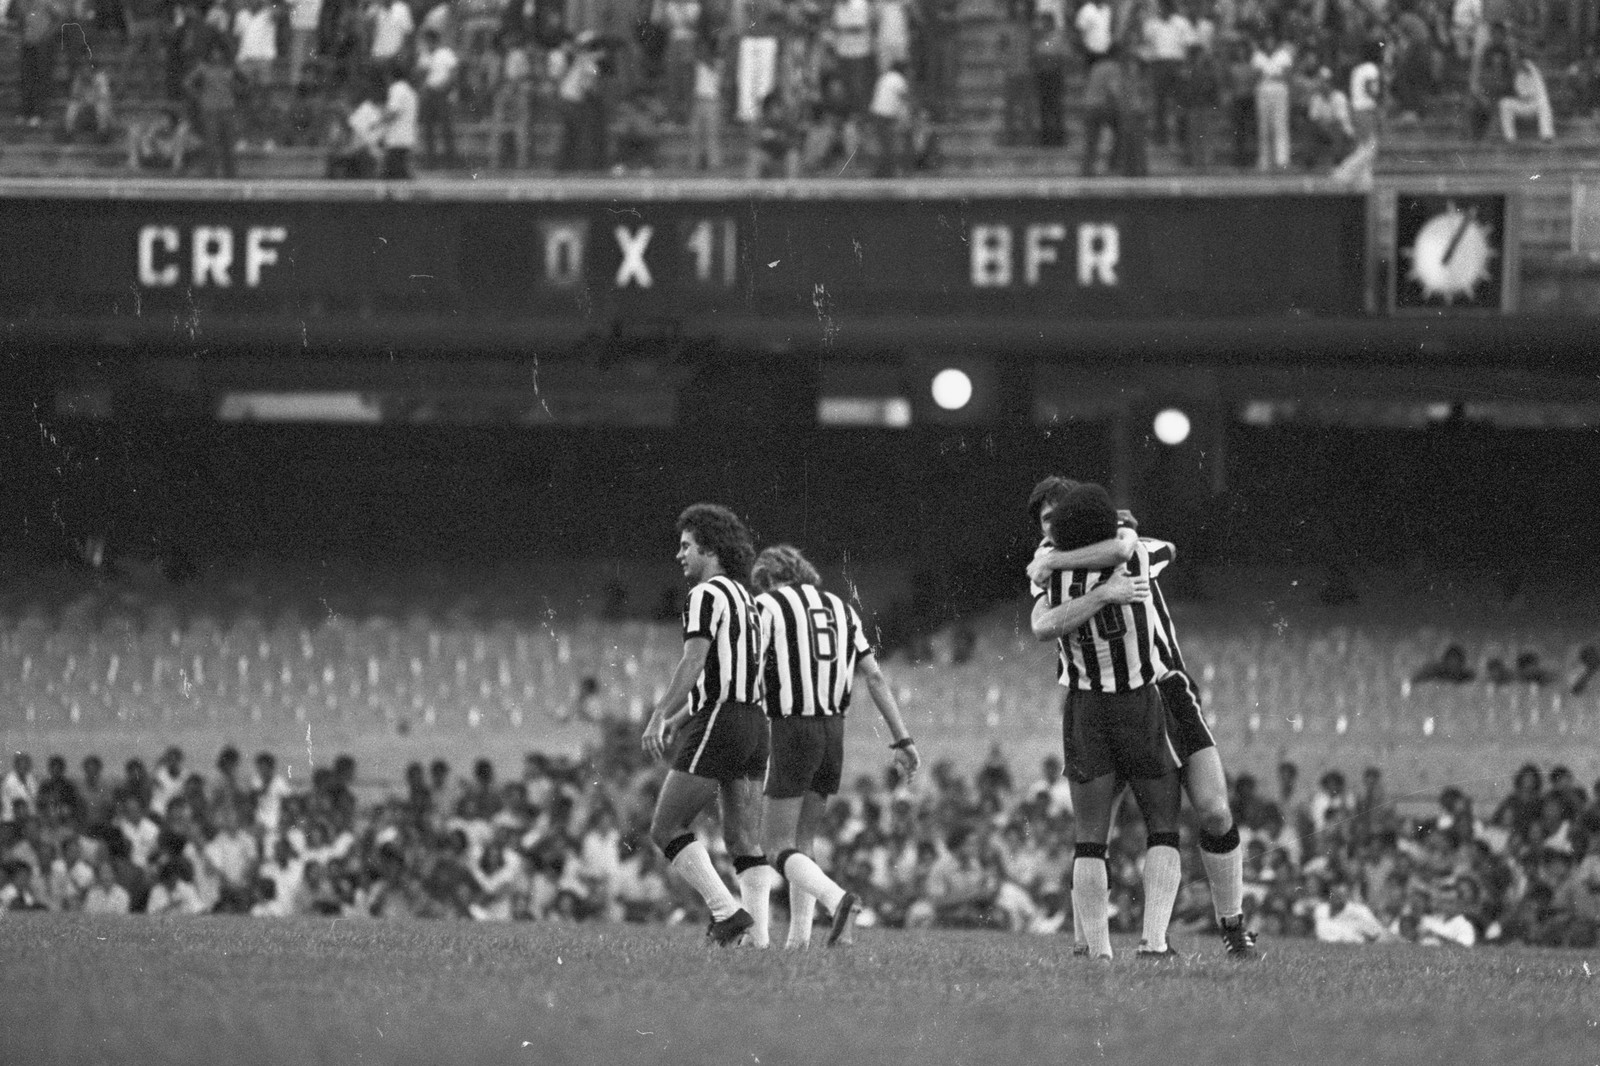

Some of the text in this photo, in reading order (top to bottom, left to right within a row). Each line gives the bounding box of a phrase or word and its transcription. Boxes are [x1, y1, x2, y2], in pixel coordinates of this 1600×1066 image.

[138, 225, 288, 286] CRF
[615, 225, 652, 287] X
[970, 223, 1120, 286] BFR
[808, 606, 837, 662] 6
